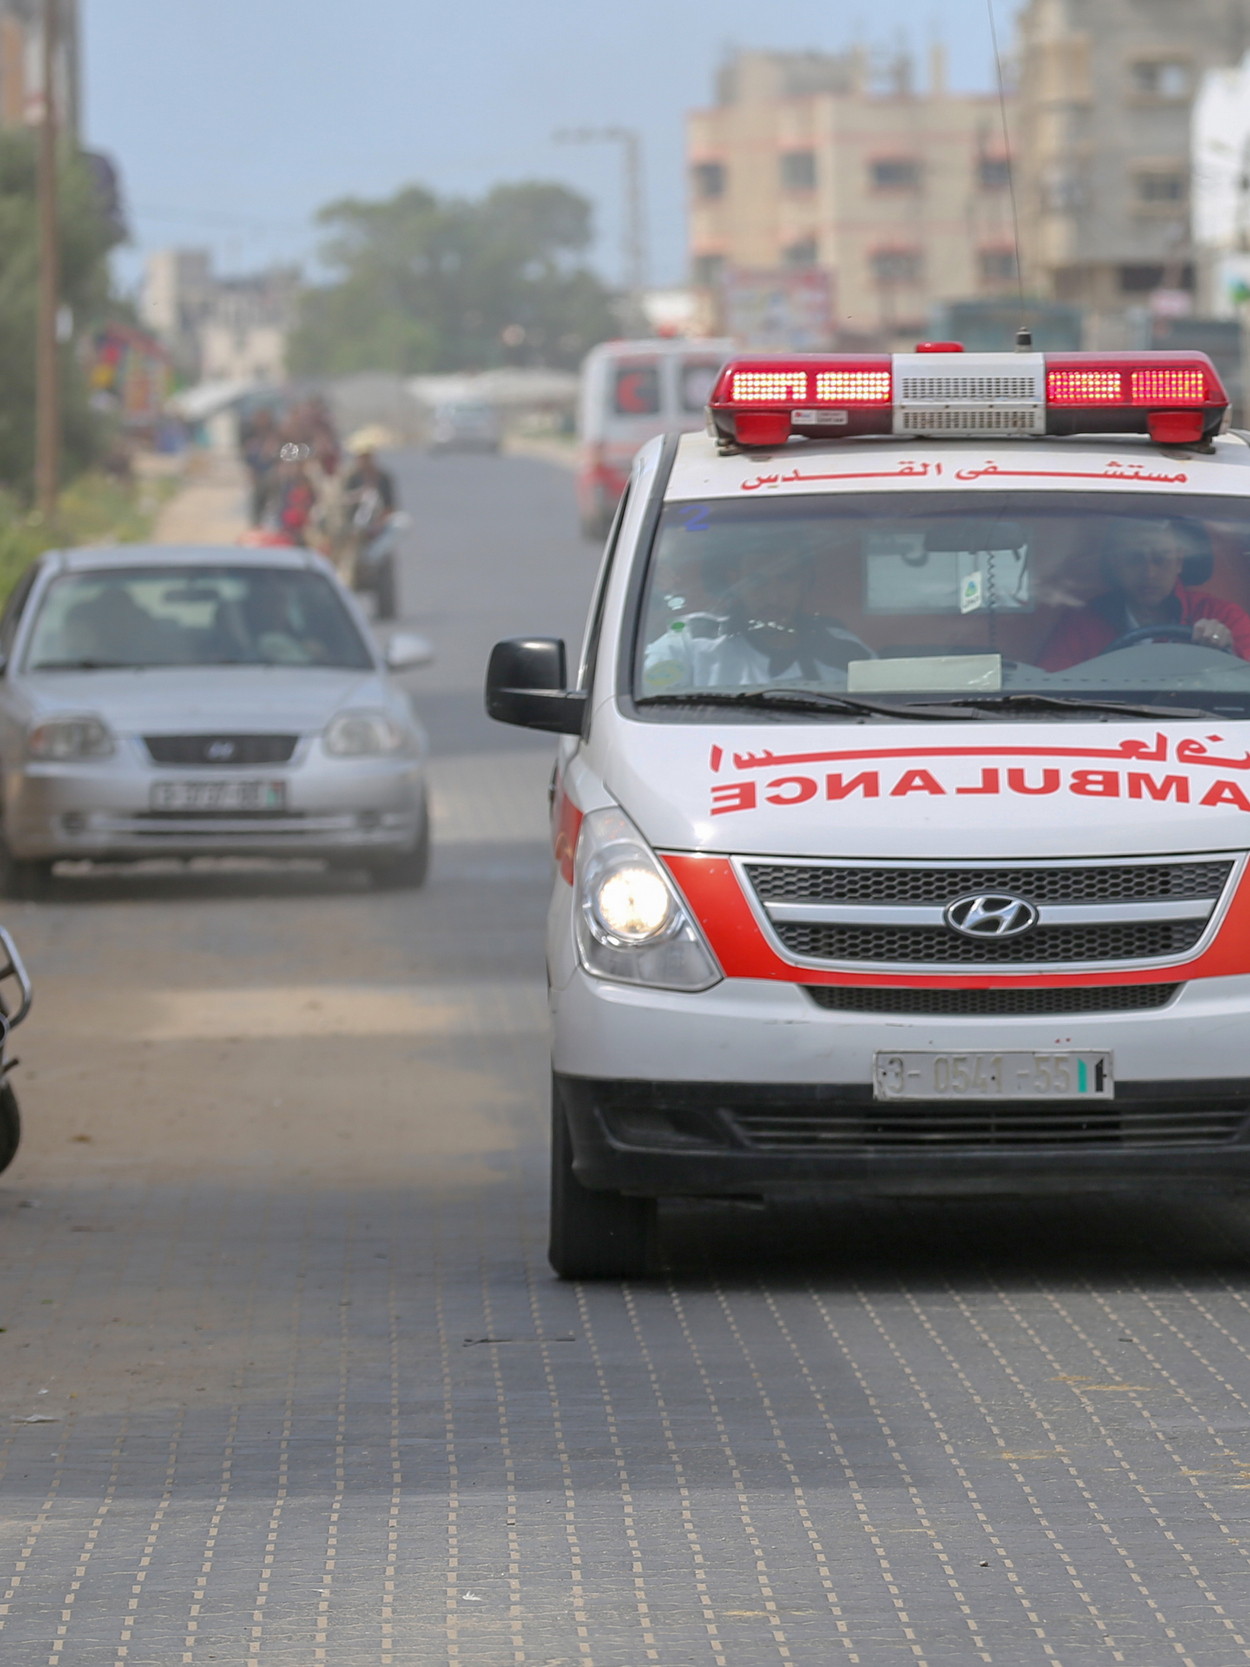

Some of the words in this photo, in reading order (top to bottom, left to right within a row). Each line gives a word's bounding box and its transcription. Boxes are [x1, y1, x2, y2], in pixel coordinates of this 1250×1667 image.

[741, 461, 943, 491] القدس
[955, 460, 1188, 484] مستشفى
[679, 504, 710, 531] 2
